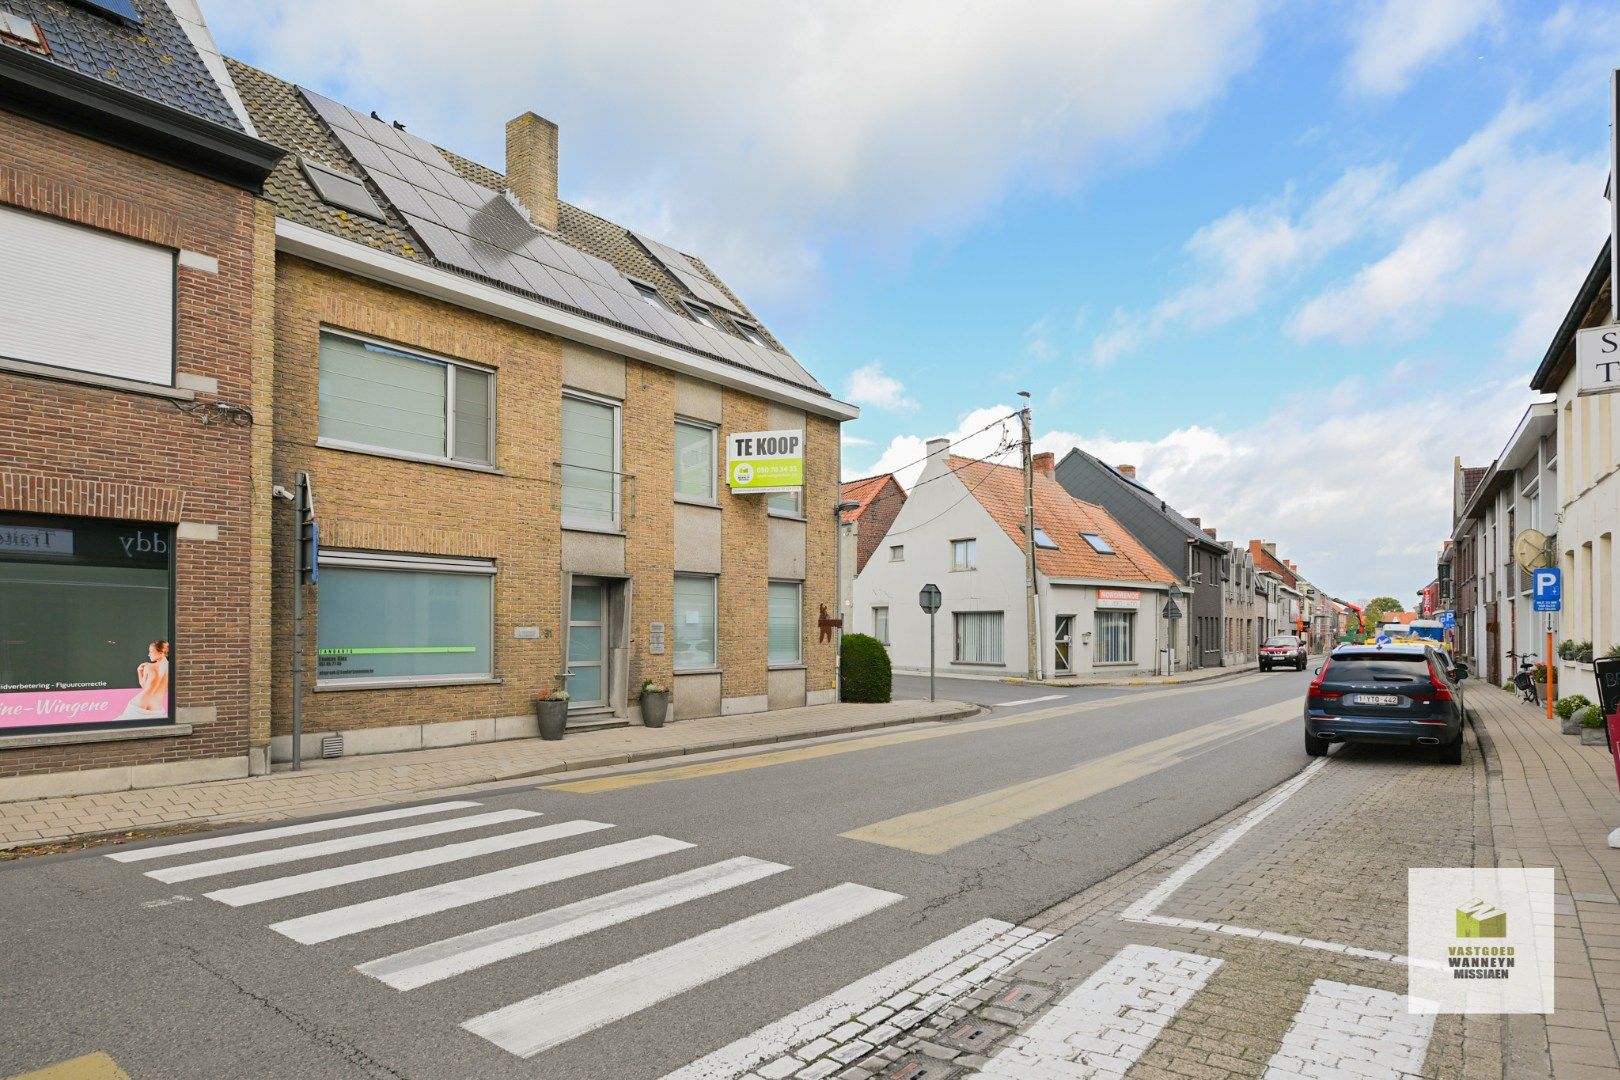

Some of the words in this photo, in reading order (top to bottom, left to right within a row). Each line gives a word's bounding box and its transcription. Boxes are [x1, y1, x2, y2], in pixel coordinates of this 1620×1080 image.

[735, 438, 753, 457] TE
[756, 436, 799, 456] KOOP
[1537, 573, 1557, 596] P
[56, 680, 107, 689] Figuurcorrectie
